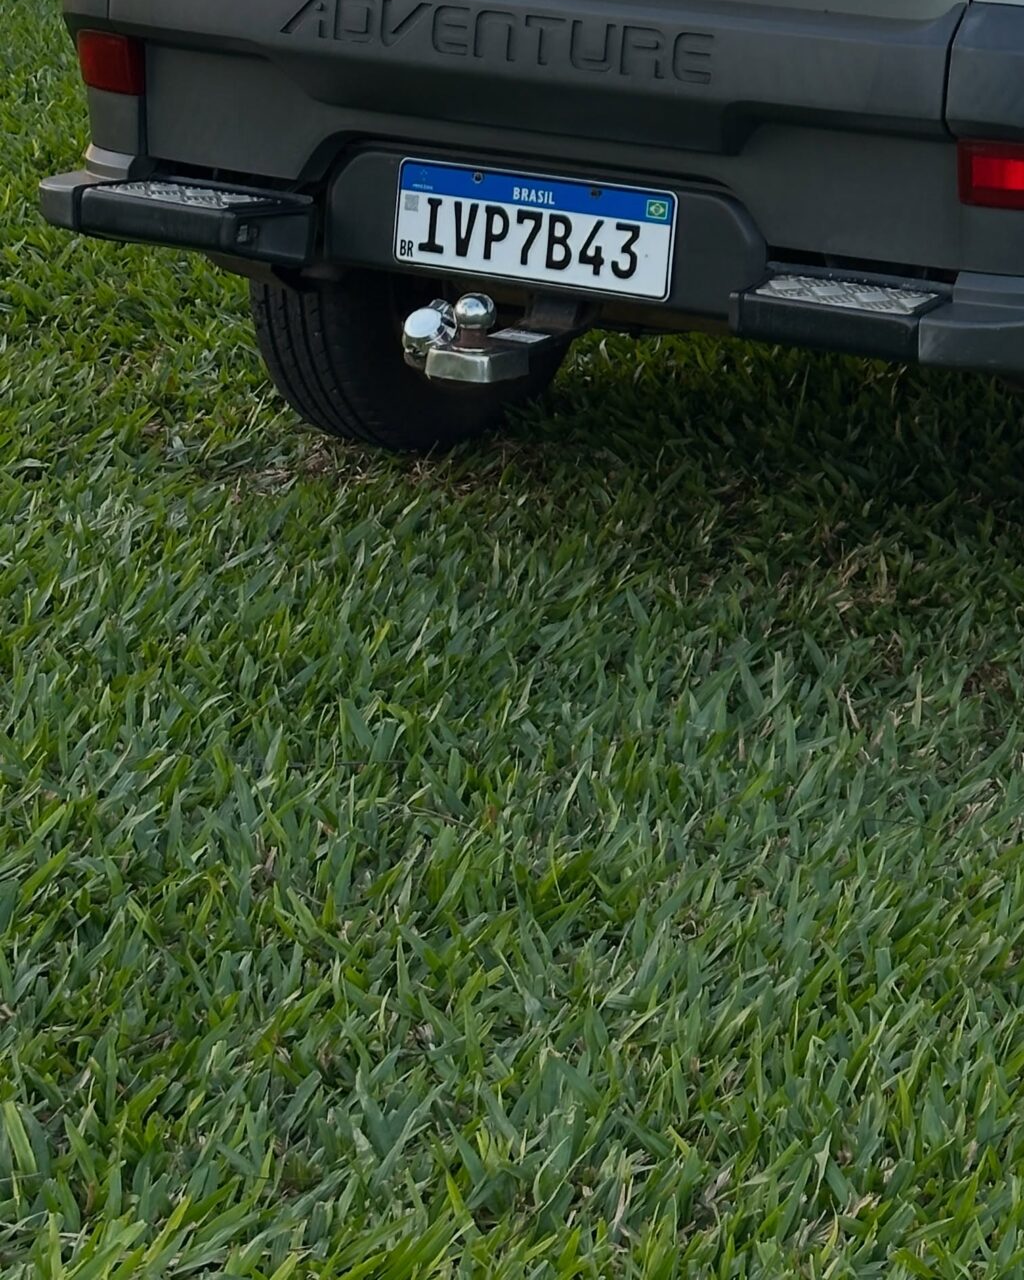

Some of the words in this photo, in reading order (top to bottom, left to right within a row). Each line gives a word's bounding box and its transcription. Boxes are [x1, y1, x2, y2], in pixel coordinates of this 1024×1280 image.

[512, 186, 555, 205] BRASIL
[417, 197, 641, 279] IVP7B43
[400, 239, 414, 258] BR
